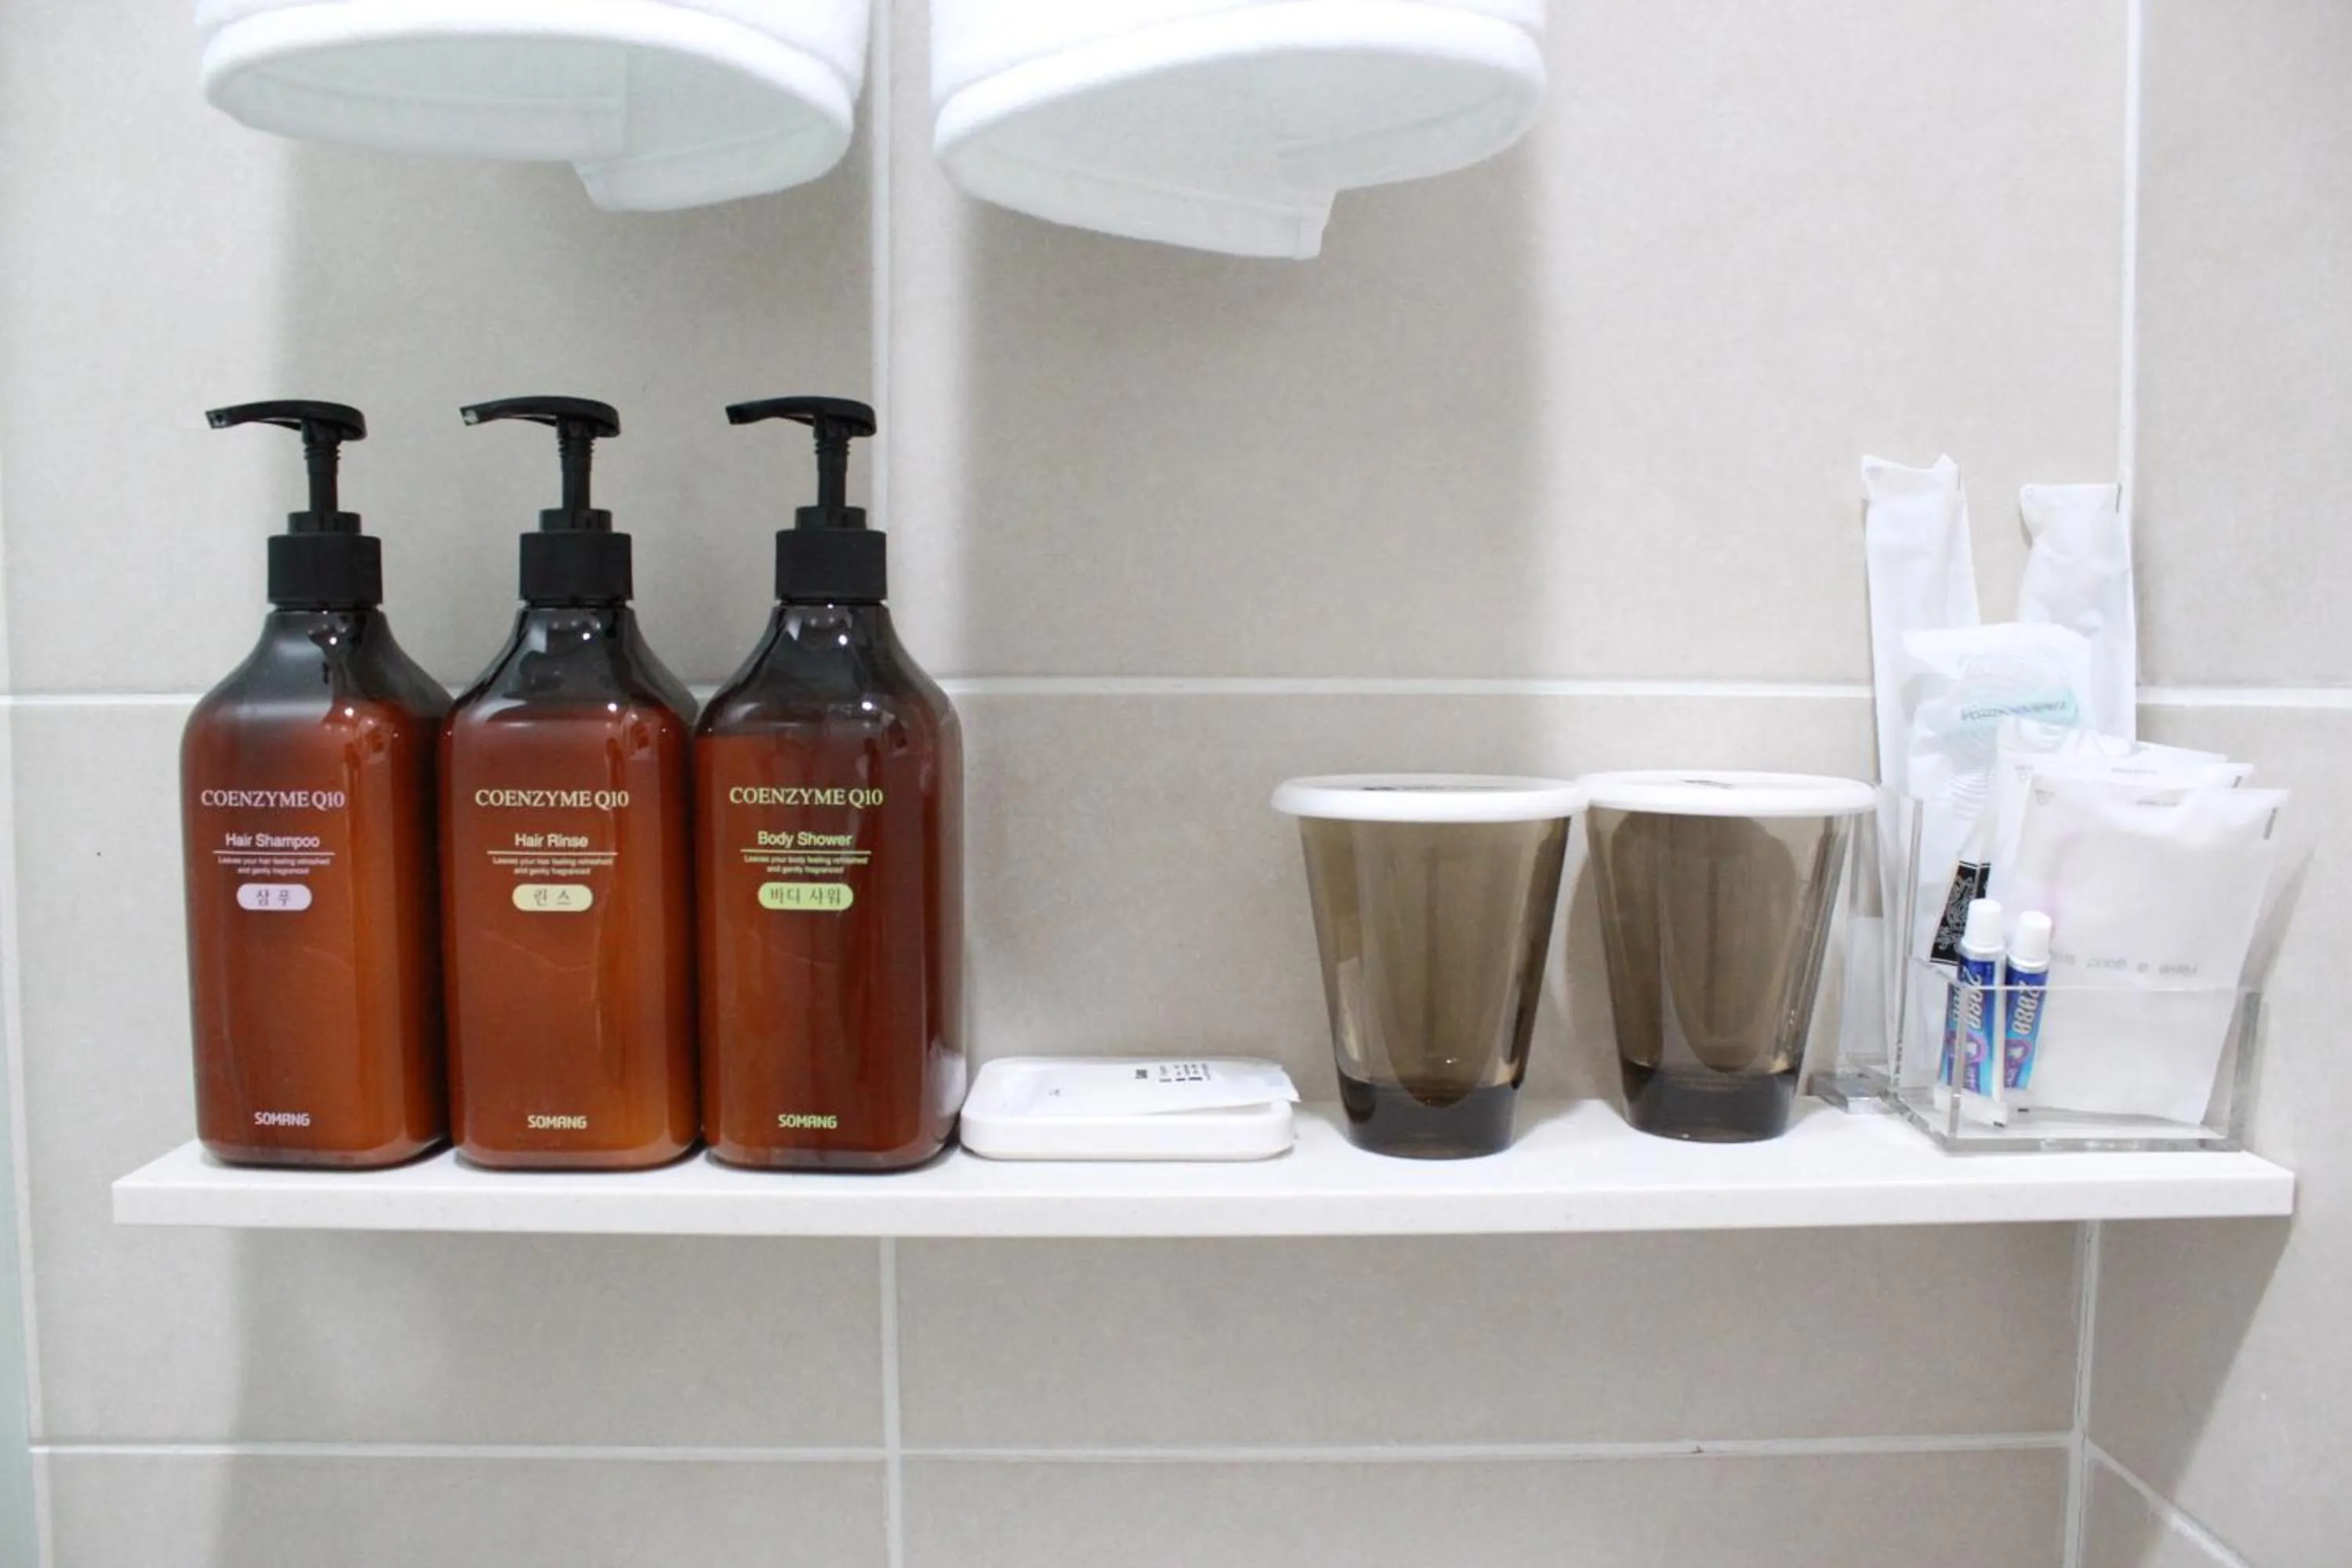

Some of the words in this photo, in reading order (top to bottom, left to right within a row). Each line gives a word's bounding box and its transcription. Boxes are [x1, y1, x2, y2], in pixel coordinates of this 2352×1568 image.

[201, 789, 309, 807] COENZYME
[311, 790, 345, 811] Q10
[475, 789, 591, 807] COENZYME
[594, 790, 630, 811] Q10
[729, 787, 846, 805] COENZYME
[848, 789, 884, 808] Q10
[225, 833, 252, 847] Hair
[255, 833, 320, 850] Shampoo
[514, 833, 544, 847] Hair
[547, 833, 589, 848] Rinse
[757, 830, 793, 848] Body
[797, 831, 853, 846] Shower
[254, 1112, 310, 1127] SOMANG
[527, 1116, 587, 1129] SOMANG
[778, 1114, 837, 1129] SOMANG
